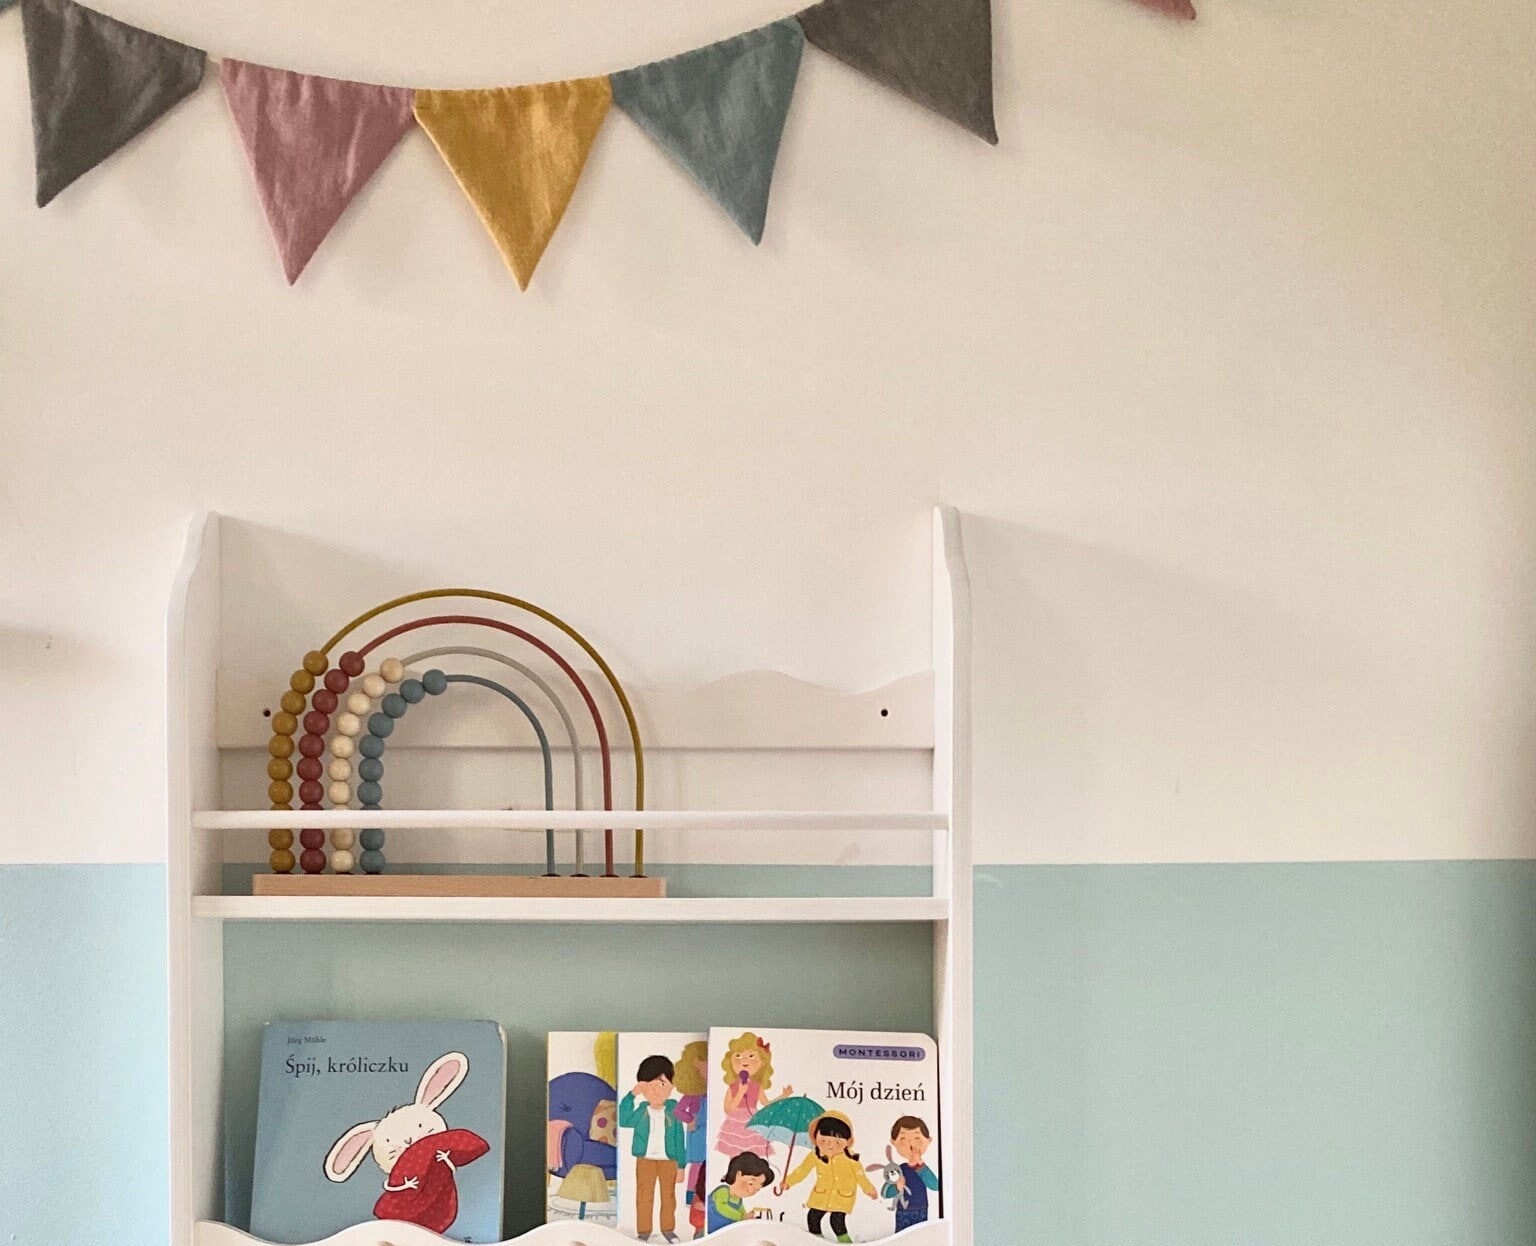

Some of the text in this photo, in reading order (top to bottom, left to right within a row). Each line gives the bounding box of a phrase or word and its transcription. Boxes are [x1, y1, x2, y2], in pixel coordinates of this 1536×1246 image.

[285, 1053, 409, 1078] Śpij, króliczku
[839, 1048, 920, 1058] MONTESSORI
[826, 1080, 926, 1105] Mój dzień
